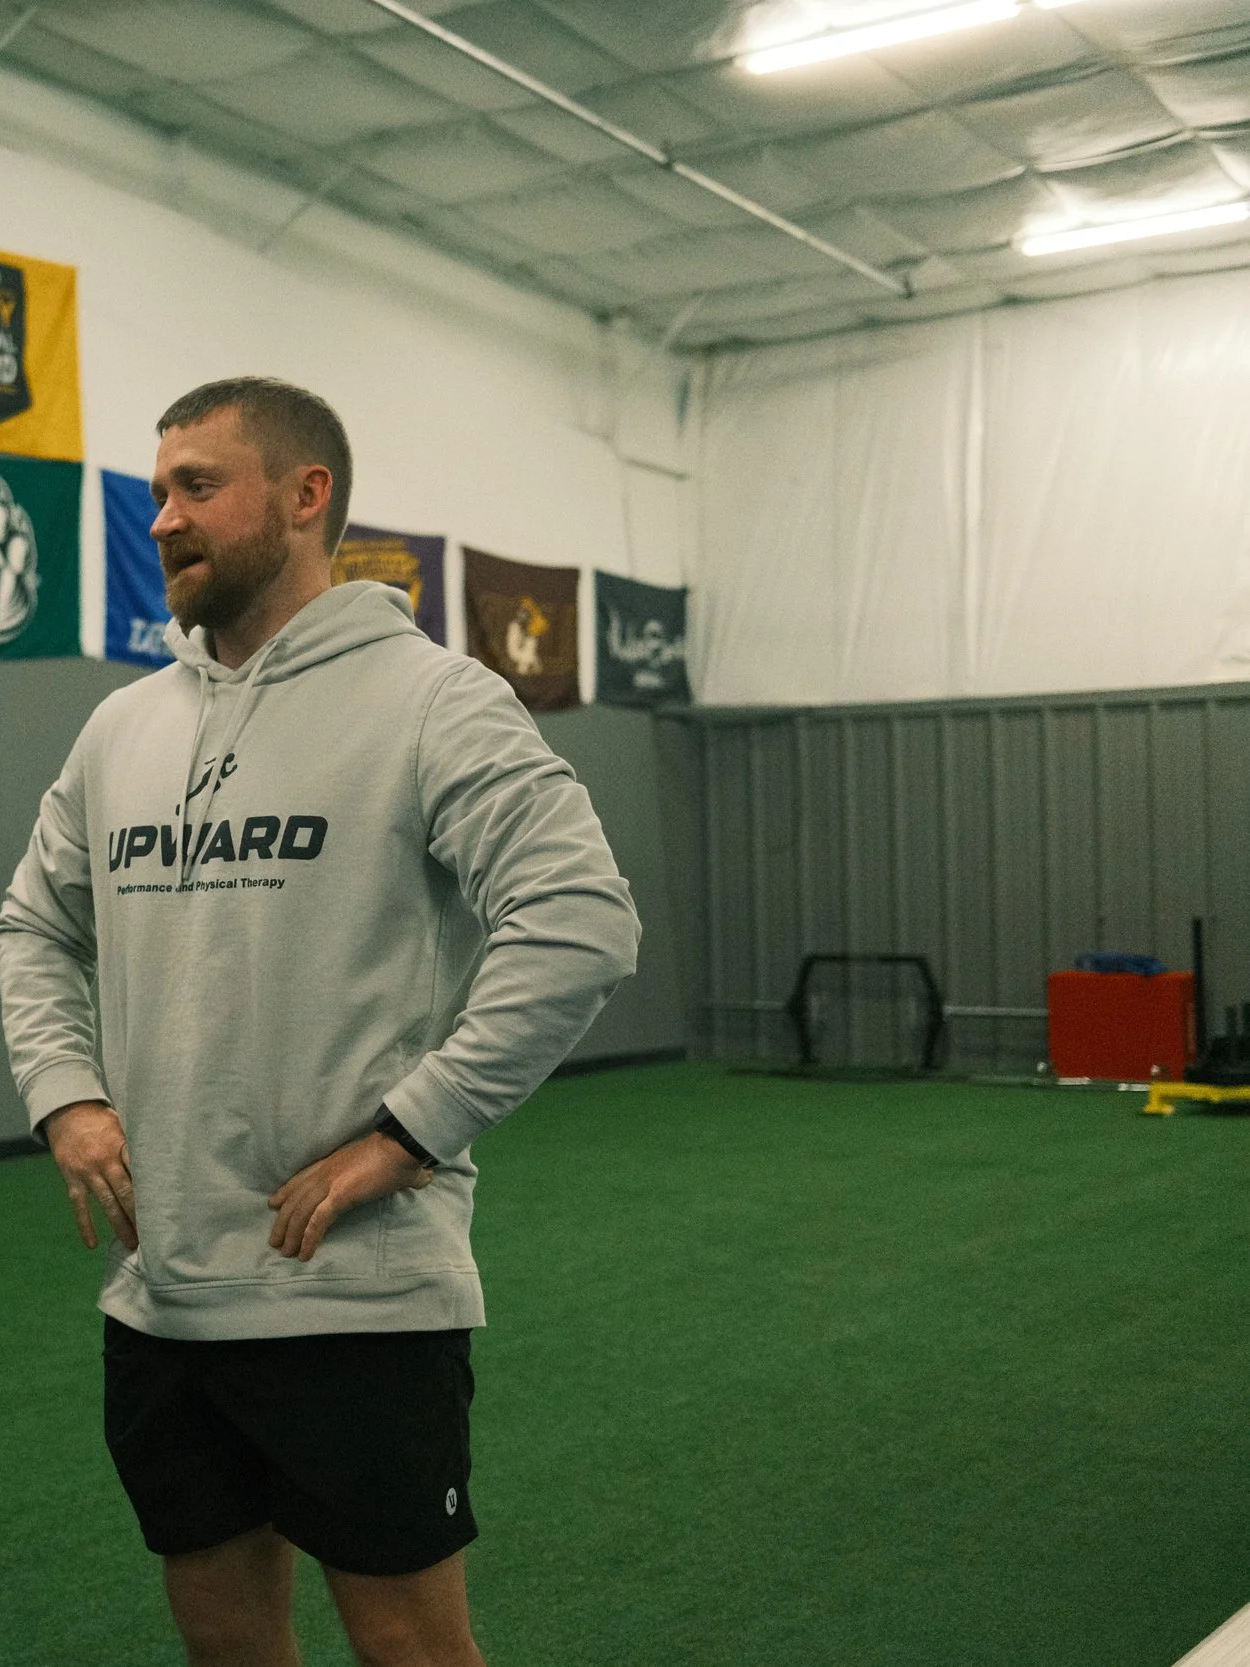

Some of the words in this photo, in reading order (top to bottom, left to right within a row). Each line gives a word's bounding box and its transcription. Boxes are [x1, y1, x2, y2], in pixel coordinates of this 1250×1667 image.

[109, 815, 328, 873] UPWARD
[117, 884, 172, 895] Performance
[196, 878, 237, 891] Physical
[241, 877, 285, 889] Therapy
